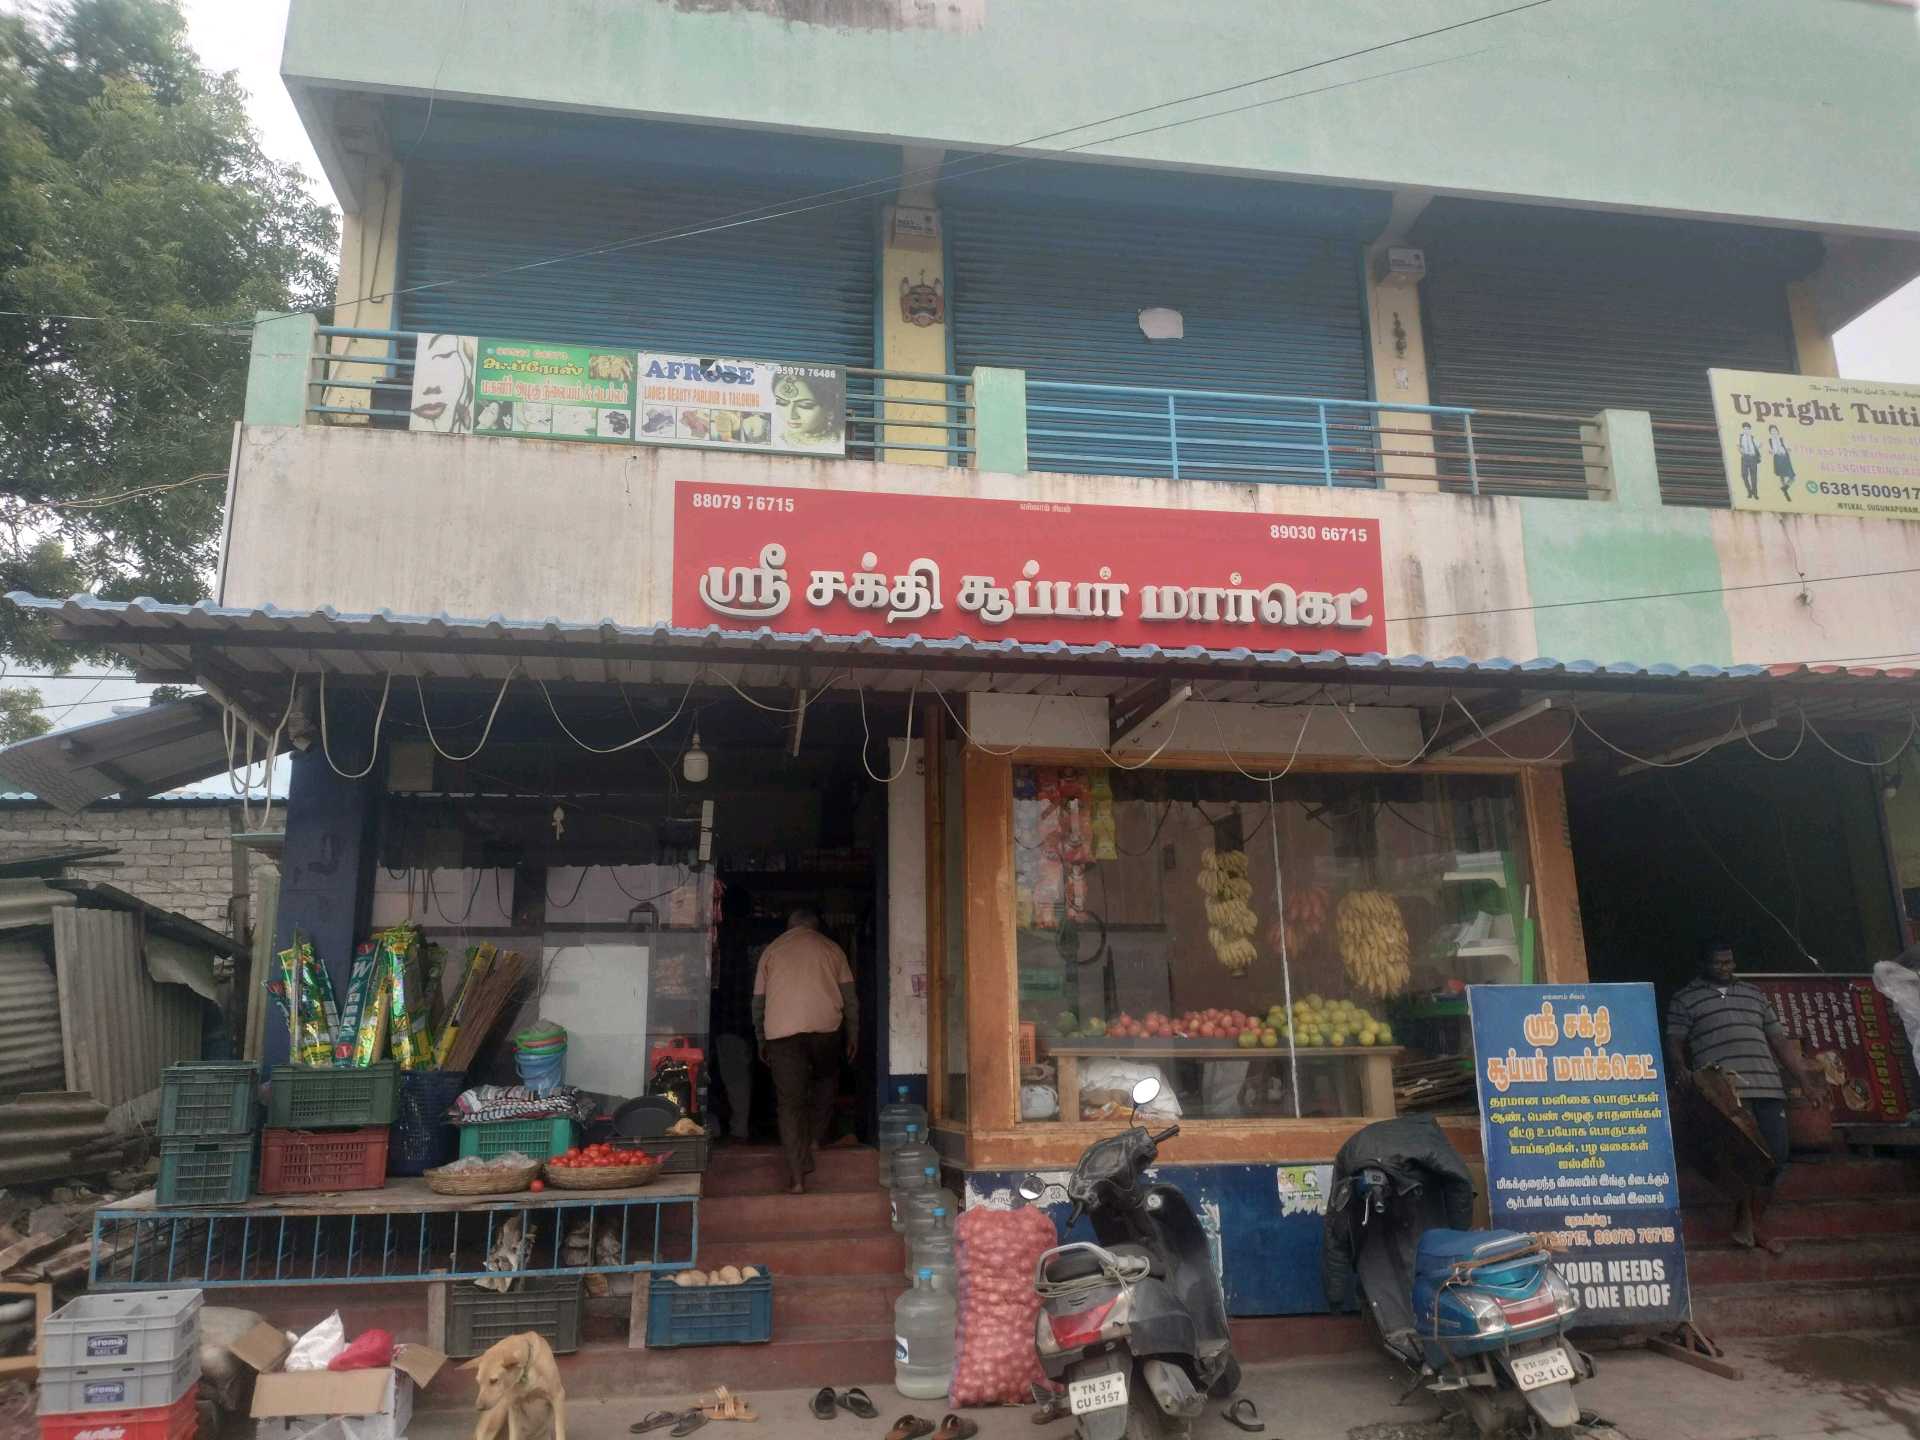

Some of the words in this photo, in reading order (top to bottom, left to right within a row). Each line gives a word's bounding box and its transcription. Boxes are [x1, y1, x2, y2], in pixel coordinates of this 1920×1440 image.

[1730, 393, 1844, 426] Upright
[693, 493, 741, 509] 88079
[747, 496, 795, 512] 76715
[1270, 524, 1316, 540] 89030
[1321, 526, 1368, 542] 66715
[806, 551, 944, 624] சக்தி
[956, 559, 1130, 623] சூப்பர்
[1139, 571, 1374, 628] மார்கெட்
[1563, 1005, 1611, 1047] சக்தி
[1488, 1048, 1548, 1092] சூப்பர்
[1553, 1046, 1657, 1082] மார்க்கெட்
[1489, 1095, 1539, 1108] தரமான
[1542, 1093, 1590, 1106] மளிகை
[1593, 1091, 1659, 1105] பொருட்கள்
[1528, 1110, 1558, 1122] பெண்
[1561, 1110, 1594, 1123] அழகு
[1596, 1107, 1662, 1121] சாதனங்கள்
[1589, 1124, 1647, 1138] பொருட்கள்
[1599, 1140, 1649, 1152] வகைகள்
[1608, 1259, 1665, 1282] NEEDS
[1585, 1286, 1621, 1309] ONE
[1623, 1284, 1671, 1307] ROOF
[1081, 1384, 1096, 1395] TN
[1099, 1380, 1111, 1391] 37
[1076, 1398, 1091, 1409] CU
[1095, 1391, 1120, 1406] 5157
